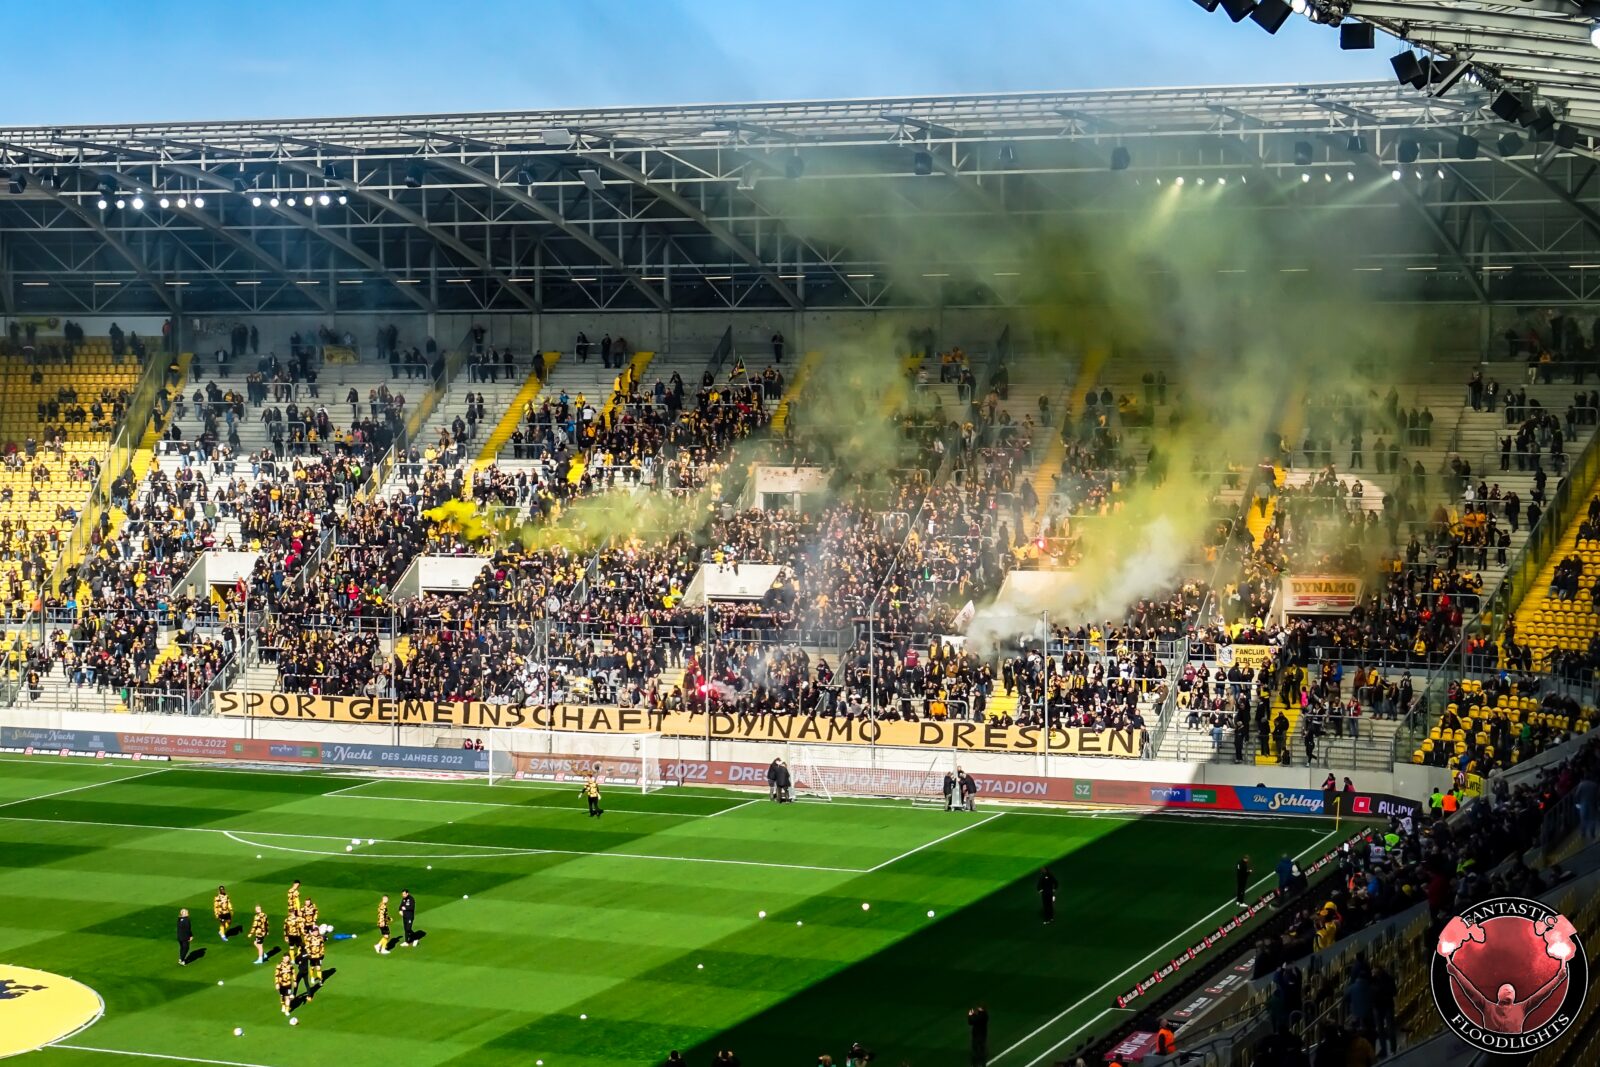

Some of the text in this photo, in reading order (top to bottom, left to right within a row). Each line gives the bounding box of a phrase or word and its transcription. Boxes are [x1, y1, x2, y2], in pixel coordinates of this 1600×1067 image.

[1292, 581, 1356, 593] DYNAMO
[1235, 648, 1265, 656] FANCLUB
[219, 692, 1133, 754] SPORTGEMEINSCHAFT DYNAMO DRESDEN
[123, 735, 168, 745] SAMSTAG
[177, 737, 227, 748] 04.06.2022
[333, 745, 373, 761] Nacht
[381, 752, 399, 761] DES
[402, 753, 438, 763] JAHRES
[441, 755, 463, 764] 2022
[1075, 783, 1090, 795] SZ
[1253, 794, 1267, 803] Die
